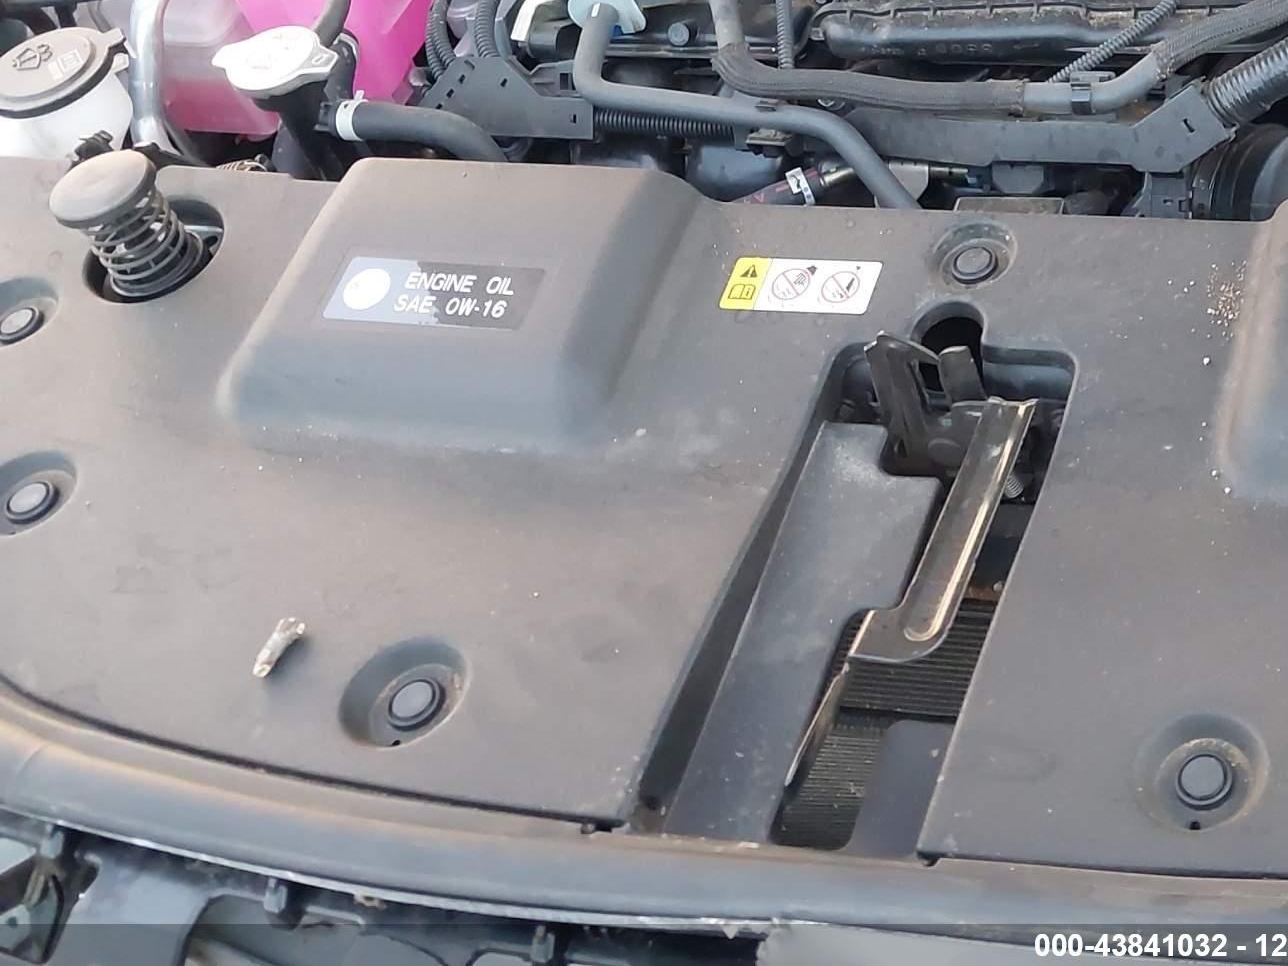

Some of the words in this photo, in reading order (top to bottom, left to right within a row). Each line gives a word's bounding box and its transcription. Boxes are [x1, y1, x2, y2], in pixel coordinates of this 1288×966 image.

[404, 271, 477, 294] ENGINE
[486, 276, 514, 296] OIL
[393, 294, 436, 314] SAE
[445, 298, 507, 318] 0W-16
